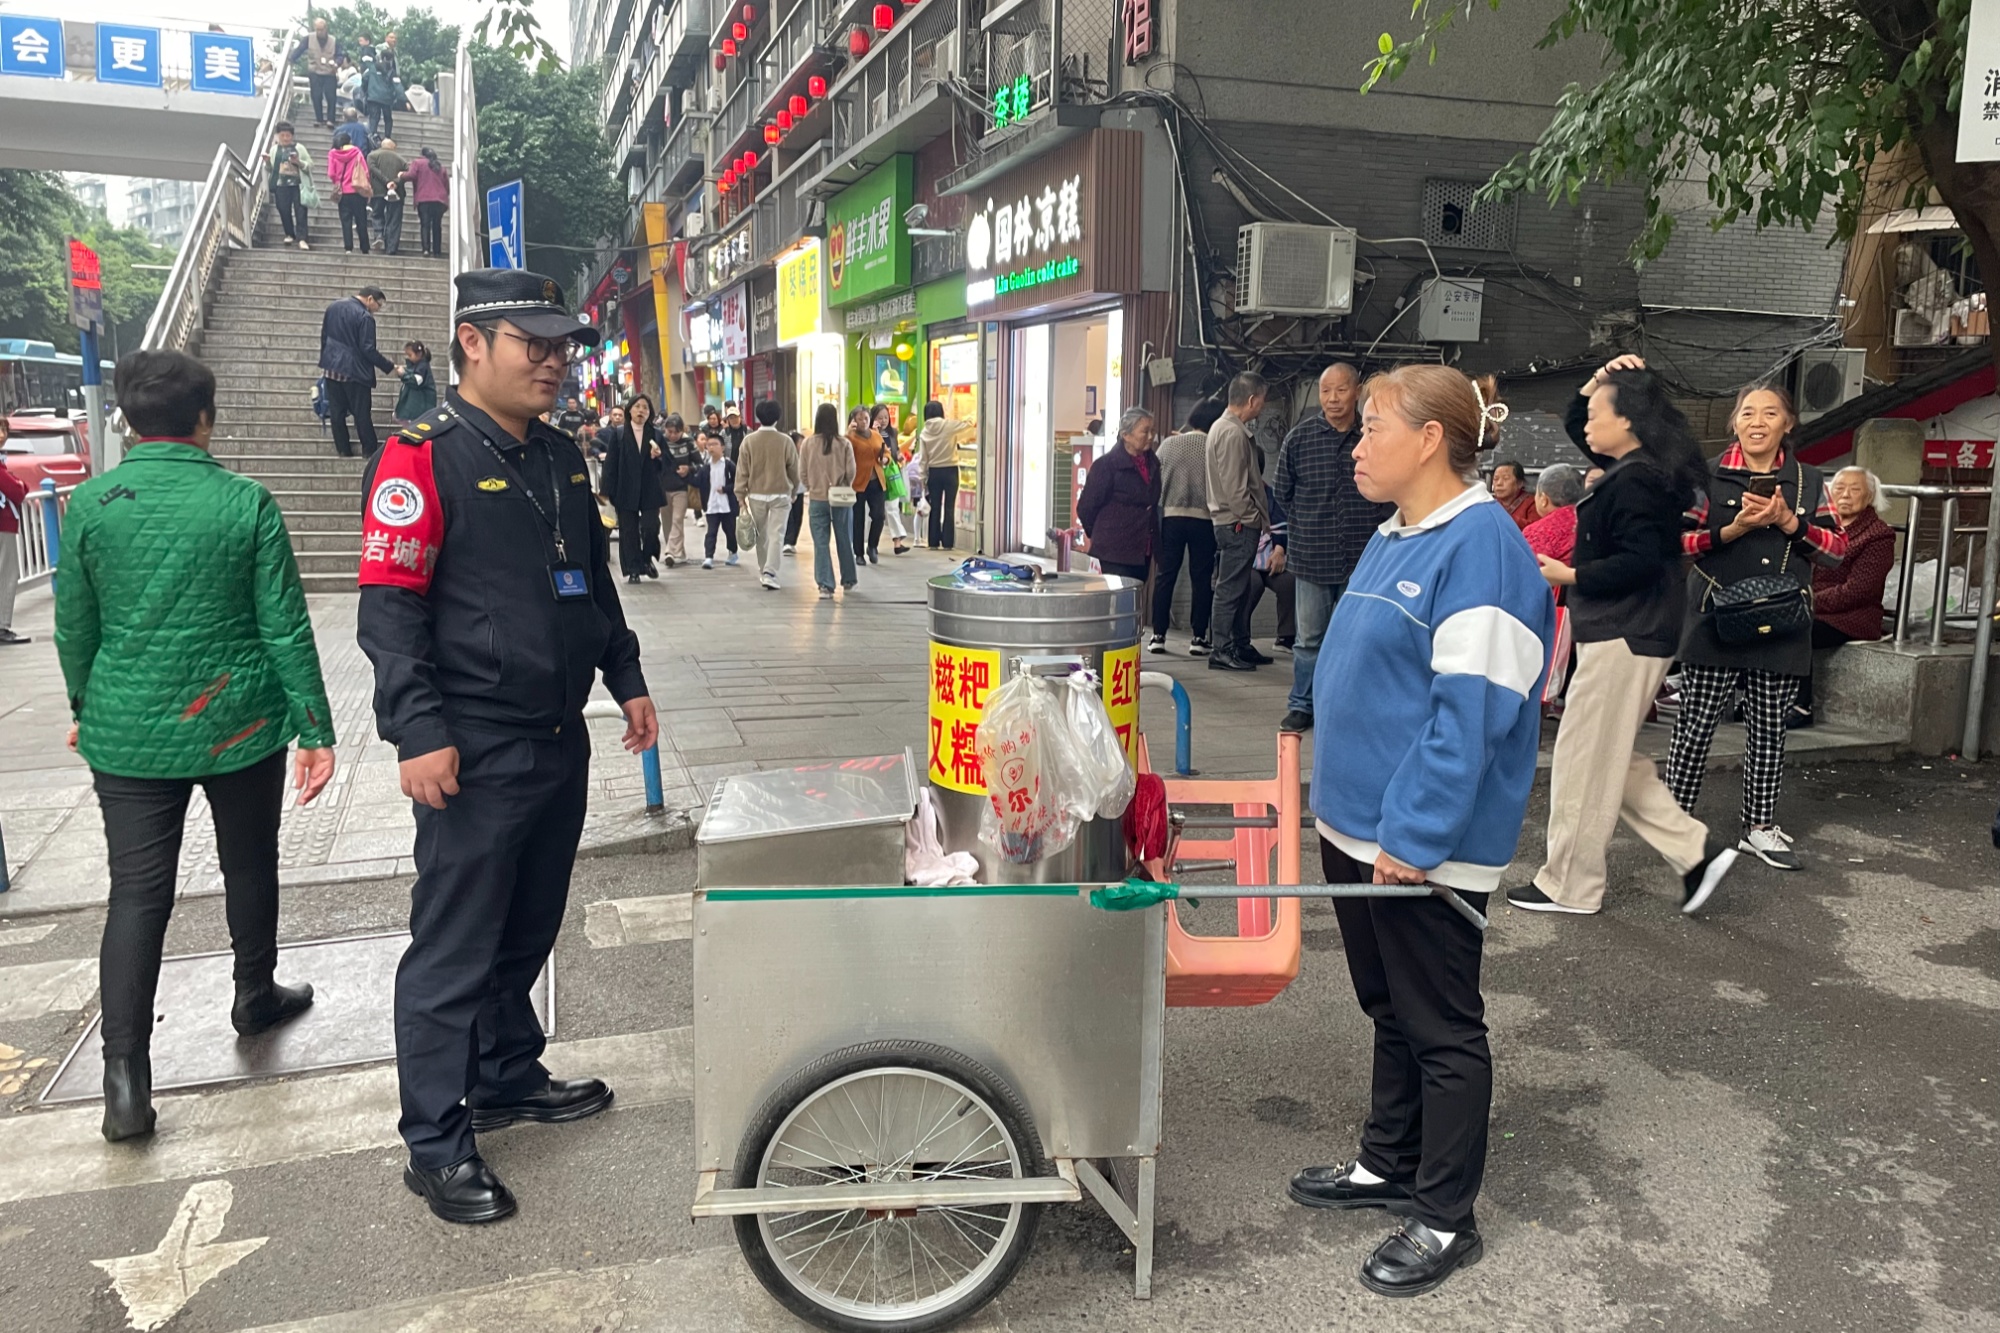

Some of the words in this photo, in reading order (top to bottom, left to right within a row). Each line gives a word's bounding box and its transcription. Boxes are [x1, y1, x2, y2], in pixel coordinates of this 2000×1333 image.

[12, 28, 241, 82] 会更美
[994, 73, 1030, 129] 茶楼
[845, 197, 891, 266] 鲜丰水果
[995, 174, 1080, 264] 国林凉糕
[1036, 259, 1056, 284] cold
[1056, 255, 1079, 278] cake
[1444, 289, 1480, 303] 公安专用
